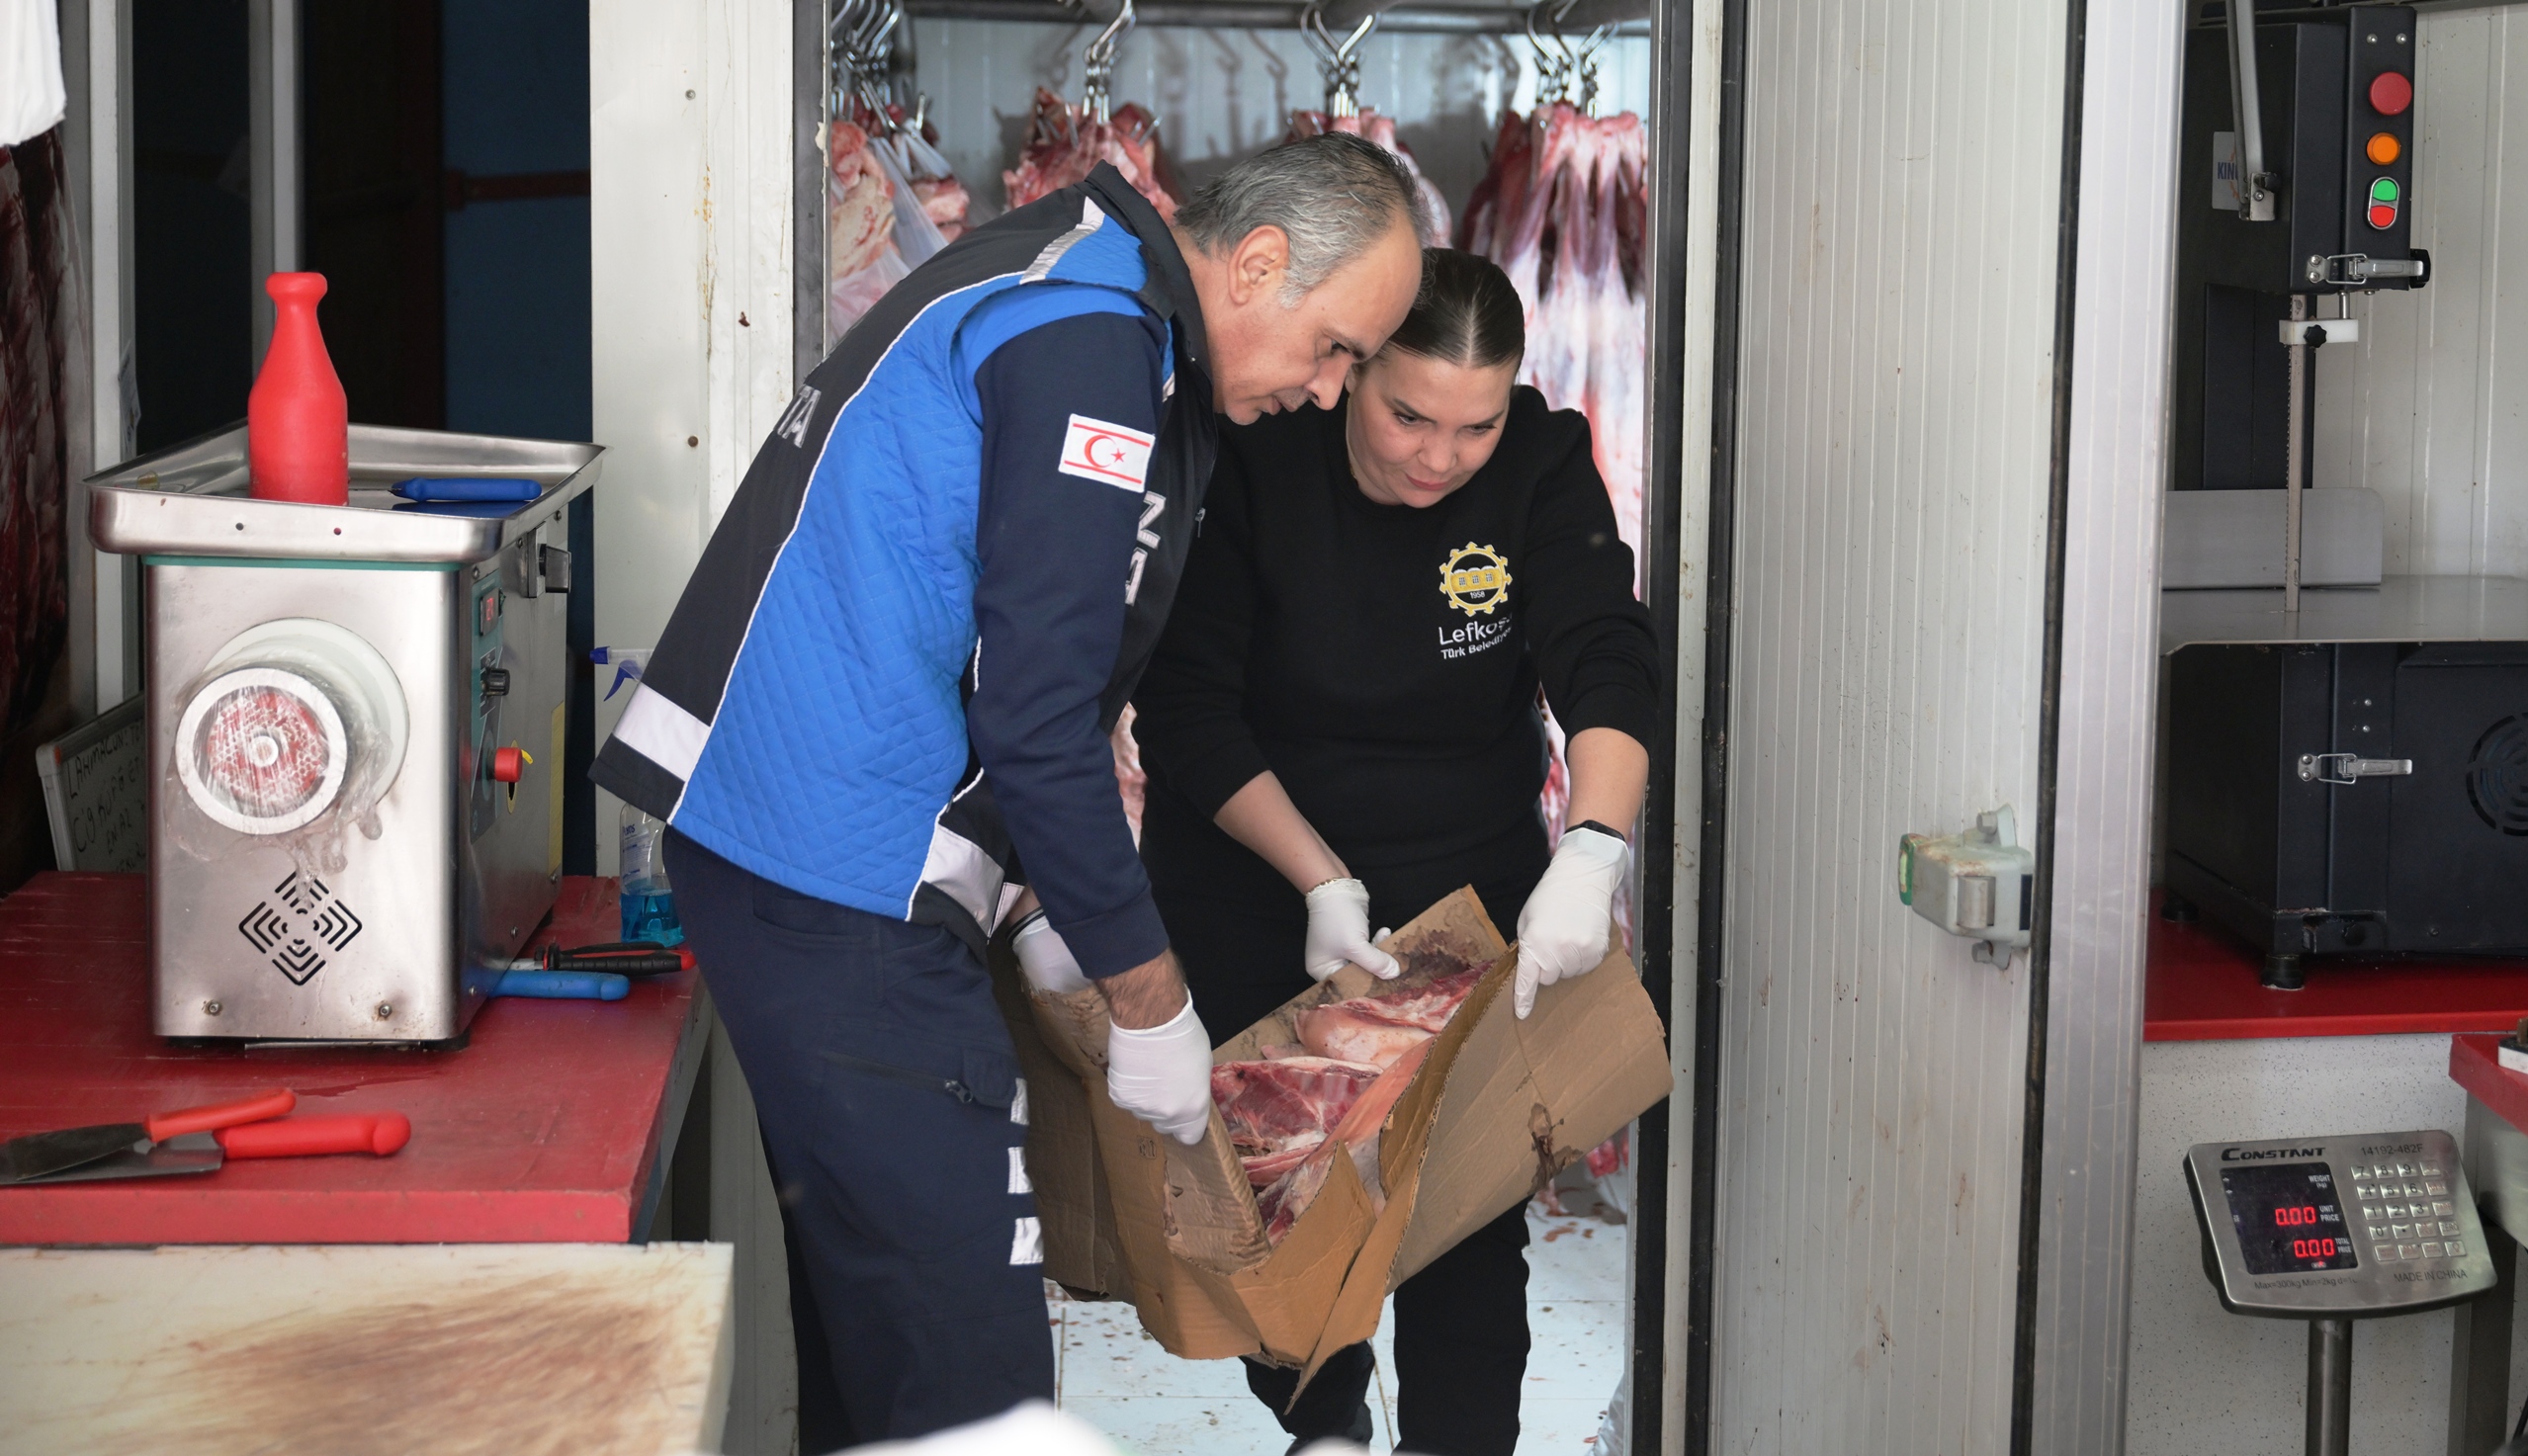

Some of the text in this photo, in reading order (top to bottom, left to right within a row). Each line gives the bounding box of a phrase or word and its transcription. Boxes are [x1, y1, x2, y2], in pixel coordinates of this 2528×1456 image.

[2218, 162, 2238, 180] KIN
[1470, 590, 1485, 599] 1958
[1440, 646, 1466, 659] Türk
[2221, 1147, 2325, 1161] CONSTANT
[2357, 1166, 2365, 1177] 7
[2380, 1165, 2389, 1176] 8
[2402, 1164, 2411, 1175] 9
[2364, 1186, 2372, 1197] 4
[2386, 1185, 2395, 1196] 5
[2409, 1183, 2418, 1194] 6
[2371, 1207, 2378, 1218] 1
[2394, 1205, 2402, 1216] 2
[2416, 1204, 2424, 1215] 3
[2376, 1226, 2384, 1237] 0
[2394, 1269, 2468, 1282] MADE IN CHINA
